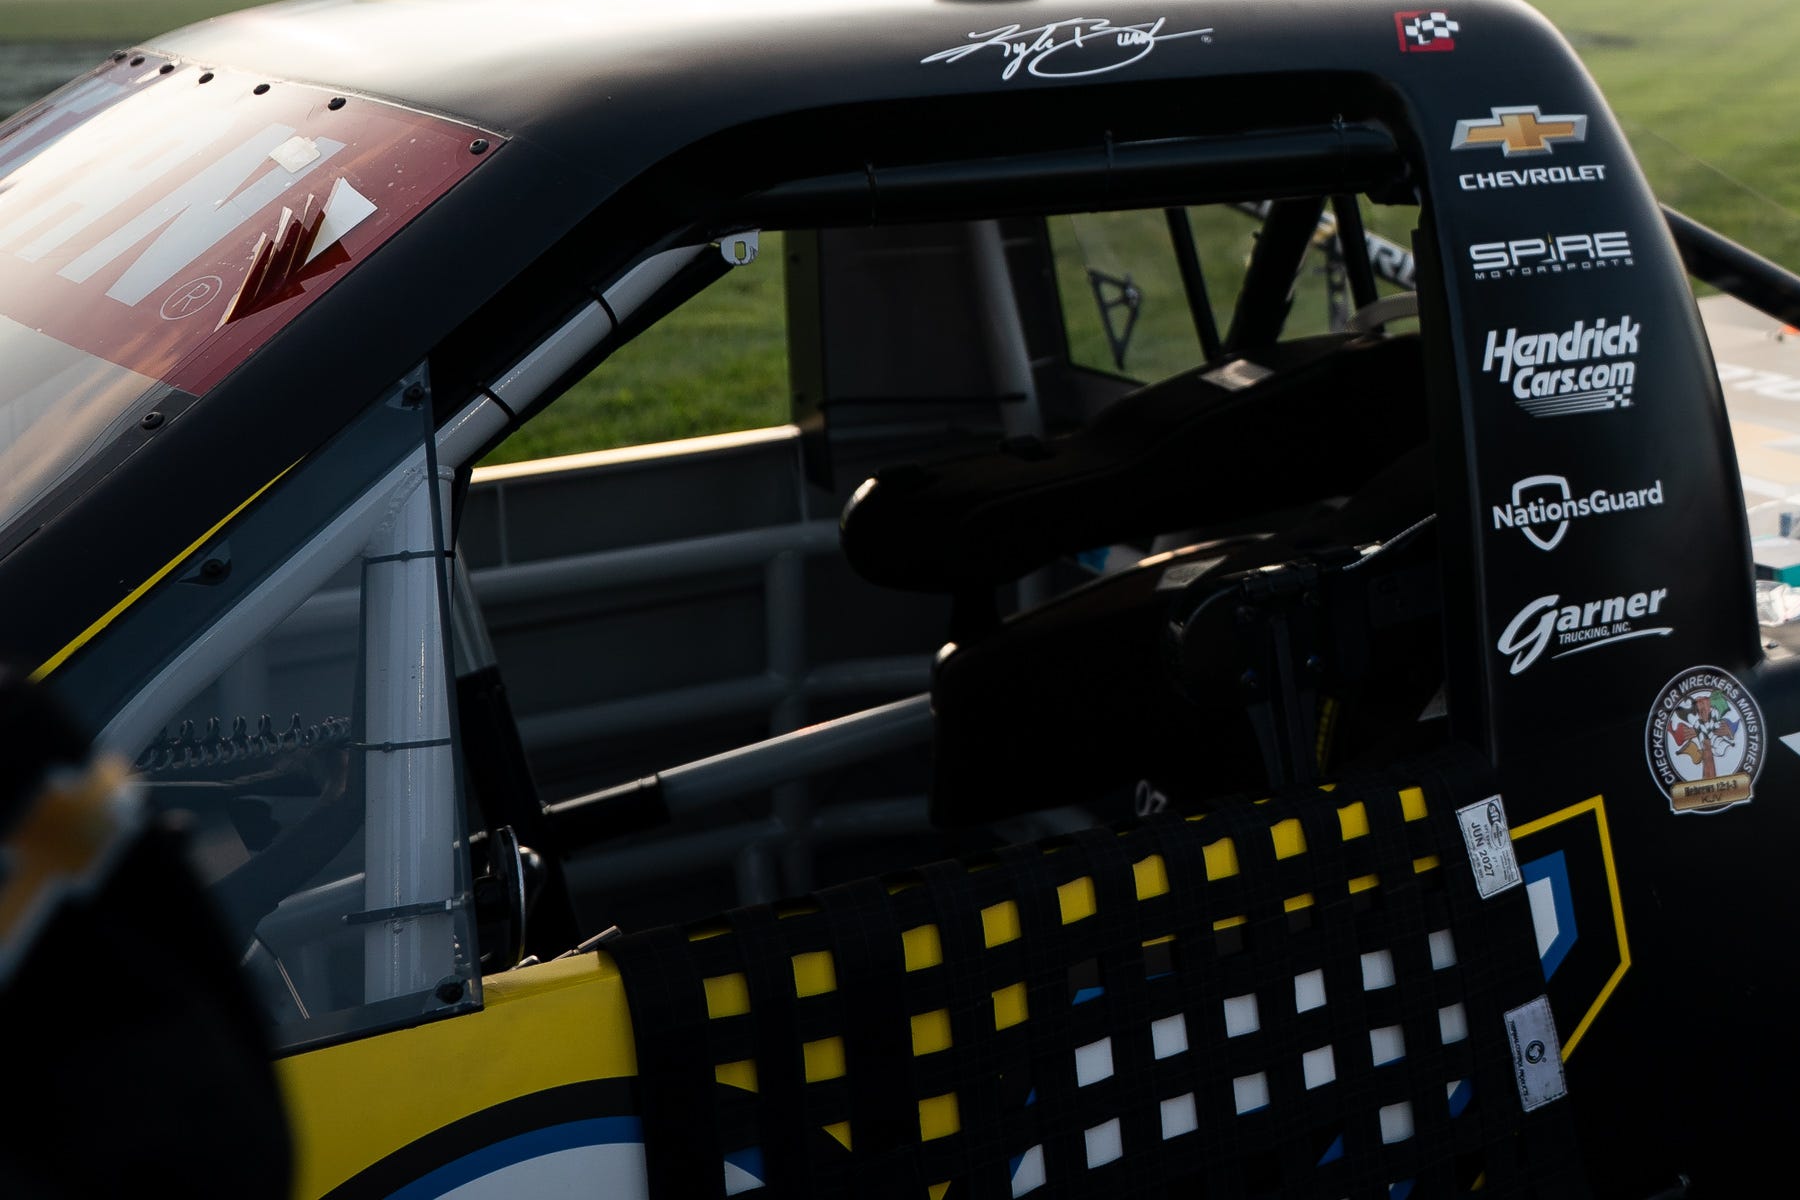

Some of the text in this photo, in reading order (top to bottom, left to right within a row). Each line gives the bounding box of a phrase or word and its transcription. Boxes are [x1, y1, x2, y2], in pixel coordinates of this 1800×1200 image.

[1458, 164, 1607, 191] CHEVROLET
[1469, 231, 1632, 271] SPIRE
[1474, 257, 1635, 281] MOTORSPORTS
[1482, 315, 1641, 383] Hendrick
[1512, 361, 1636, 400] Cars.com
[1491, 479, 1664, 530] NationsGuard
[1497, 587, 1668, 675] Garner
[1558, 621, 1632, 645] TRUCKING, INC.
[1653, 674, 1759, 785] CHECKERS OR WRECKERS MINISTRIES
[1470, 821, 1485, 848] JUN
[1478, 849, 1496, 878] 2027
